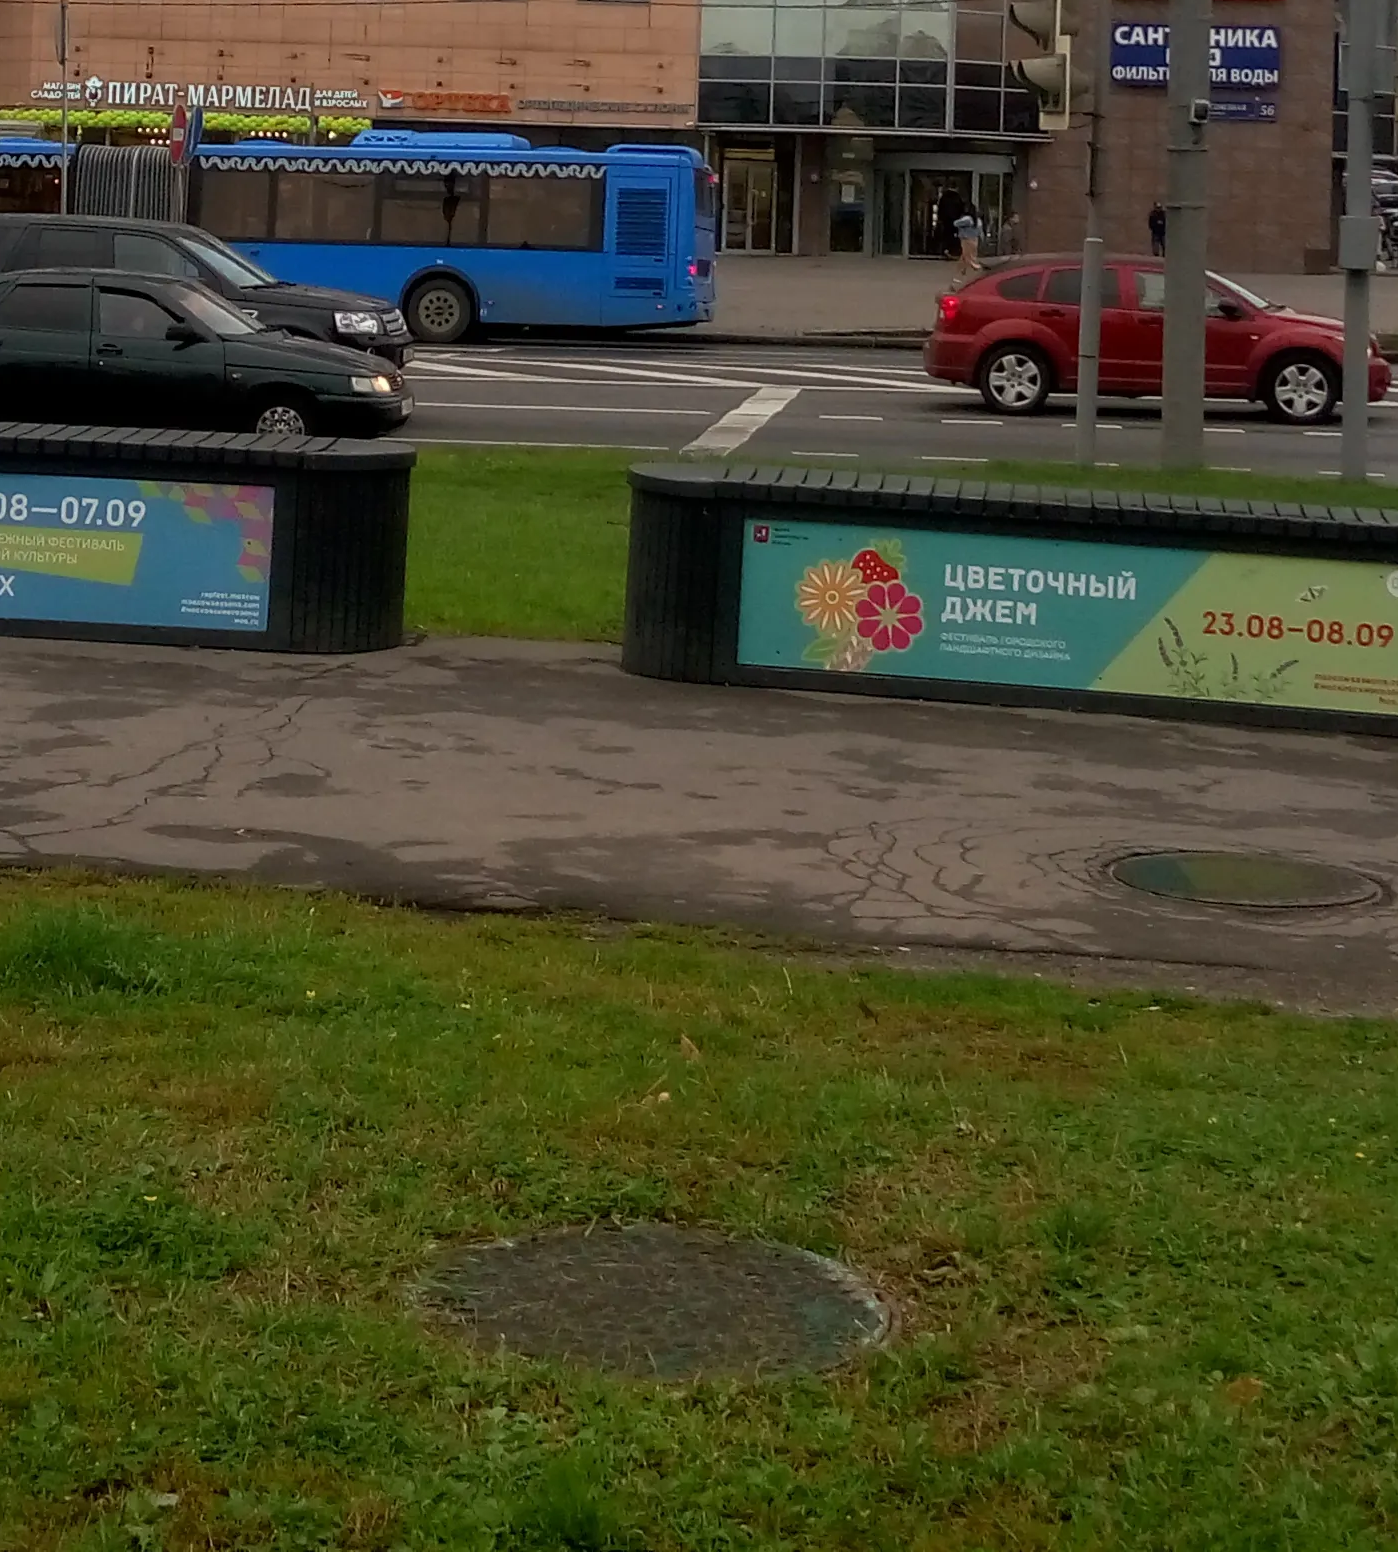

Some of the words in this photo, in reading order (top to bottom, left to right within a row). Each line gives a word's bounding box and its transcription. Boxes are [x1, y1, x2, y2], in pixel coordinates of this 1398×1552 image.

[1114, 26, 1279, 48] САННИКА
[1112, 65, 1170, 81] ФИЛЬТ
[1230, 69, 1279, 86] ВОДЫ
[30, 89, 81, 99] СЛАДОТЕЙ
[107, 80, 312, 113] ПИРАТ-МАРМЕЛАД
[48, 536, 126, 553] ФЕСТИВАЛЬ
[13, 550, 78, 565] КУЛЬТУРЫ
[944, 563, 1137, 600] ЦВЕТОЧНЫЙ
[941, 596, 1037, 626] ДЖЕМ
